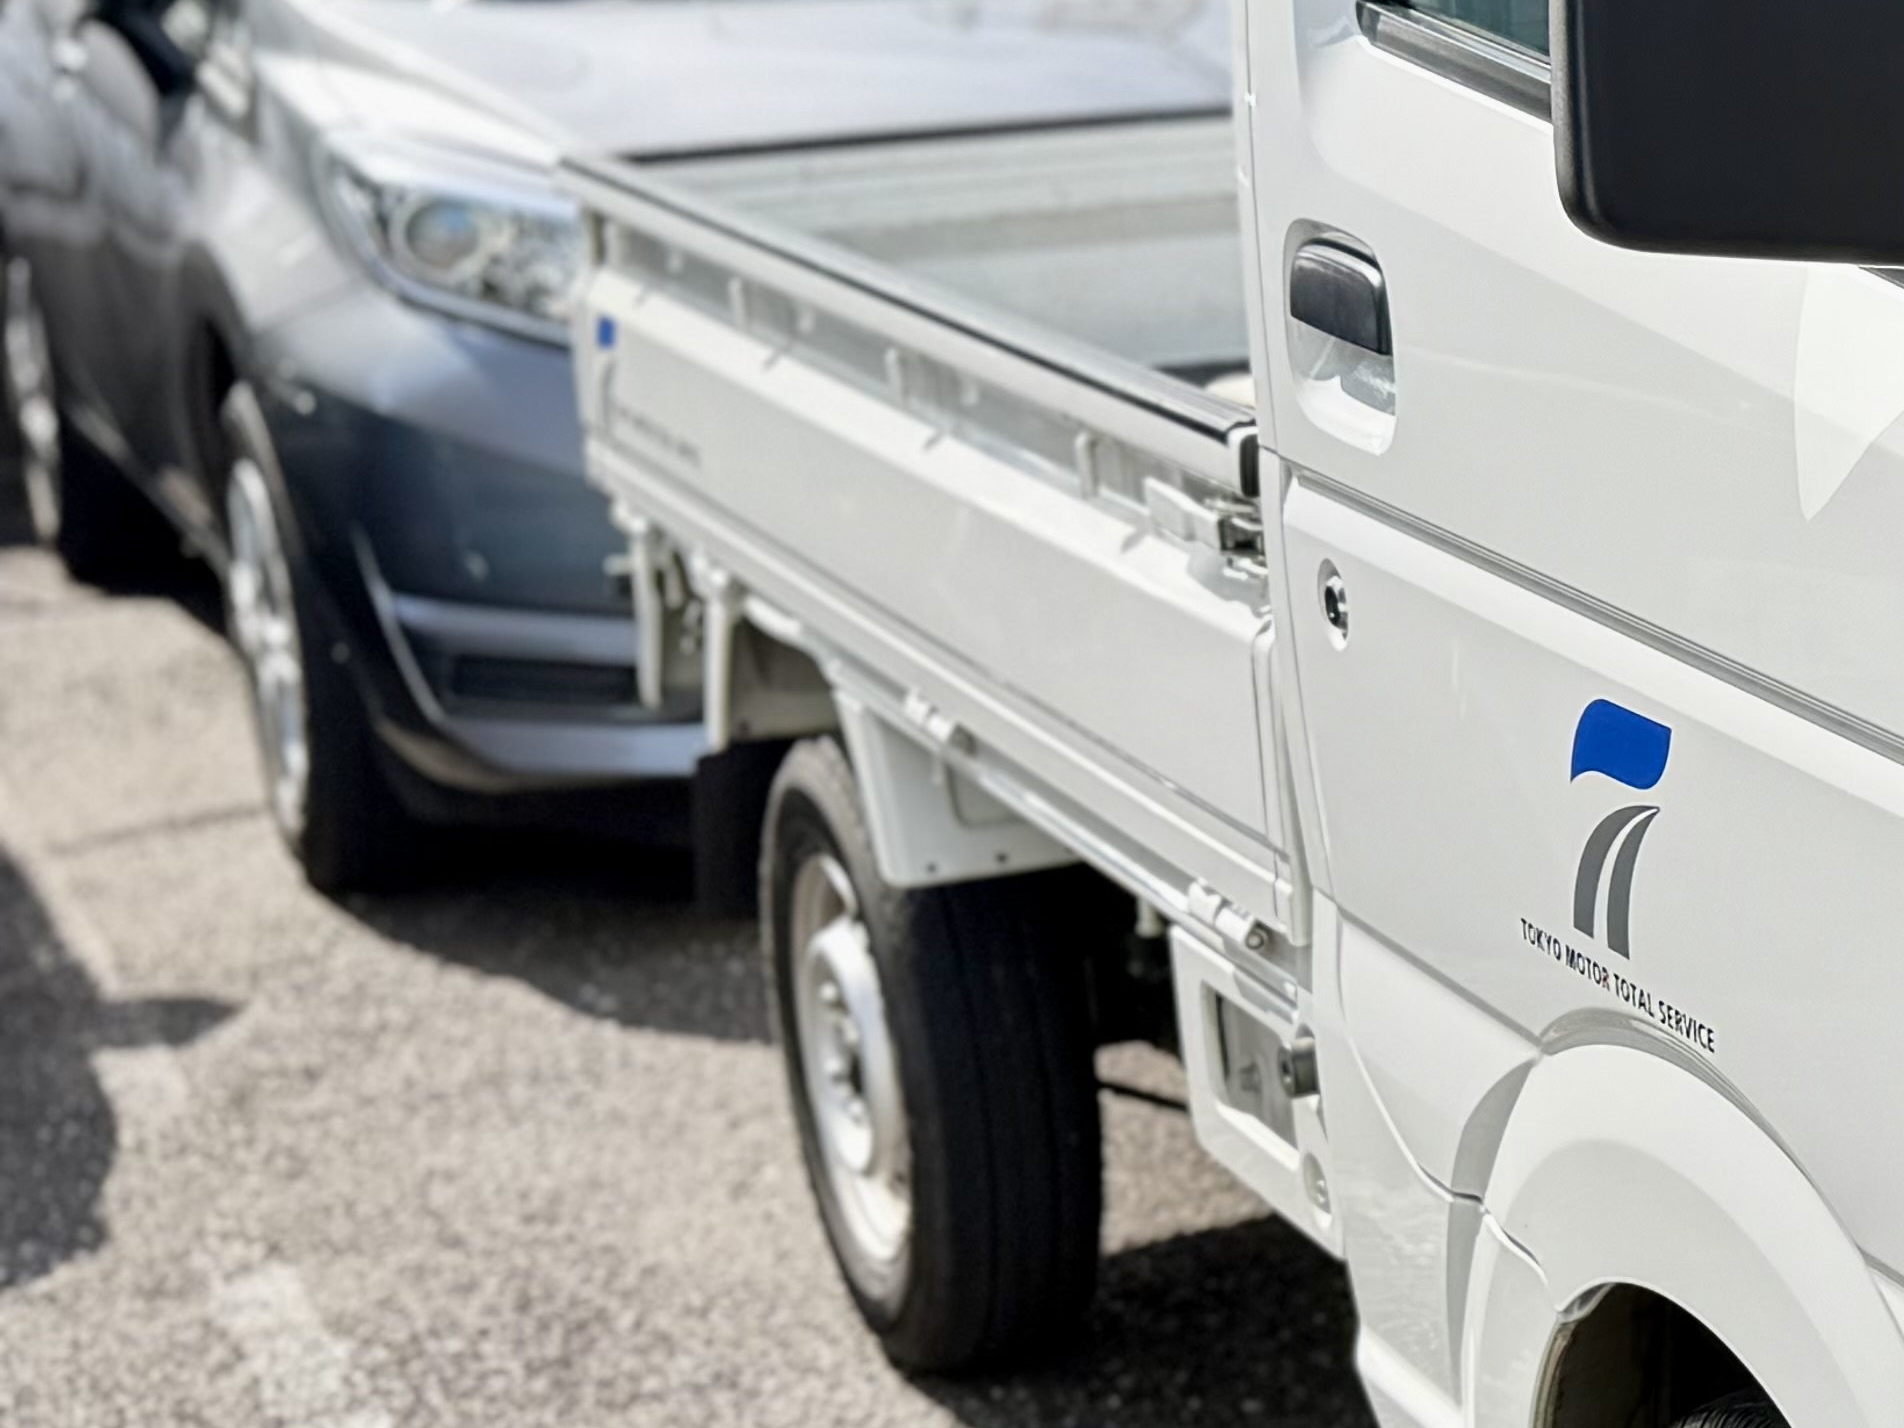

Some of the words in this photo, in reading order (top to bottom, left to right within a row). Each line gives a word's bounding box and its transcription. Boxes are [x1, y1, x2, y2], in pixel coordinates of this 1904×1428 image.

[1520, 917, 1562, 962] TOKYO
[1565, 944, 1610, 989] MOTOR
[1612, 973, 1655, 1019] TOTAL
[1658, 1000, 1716, 1054] SERVICE
